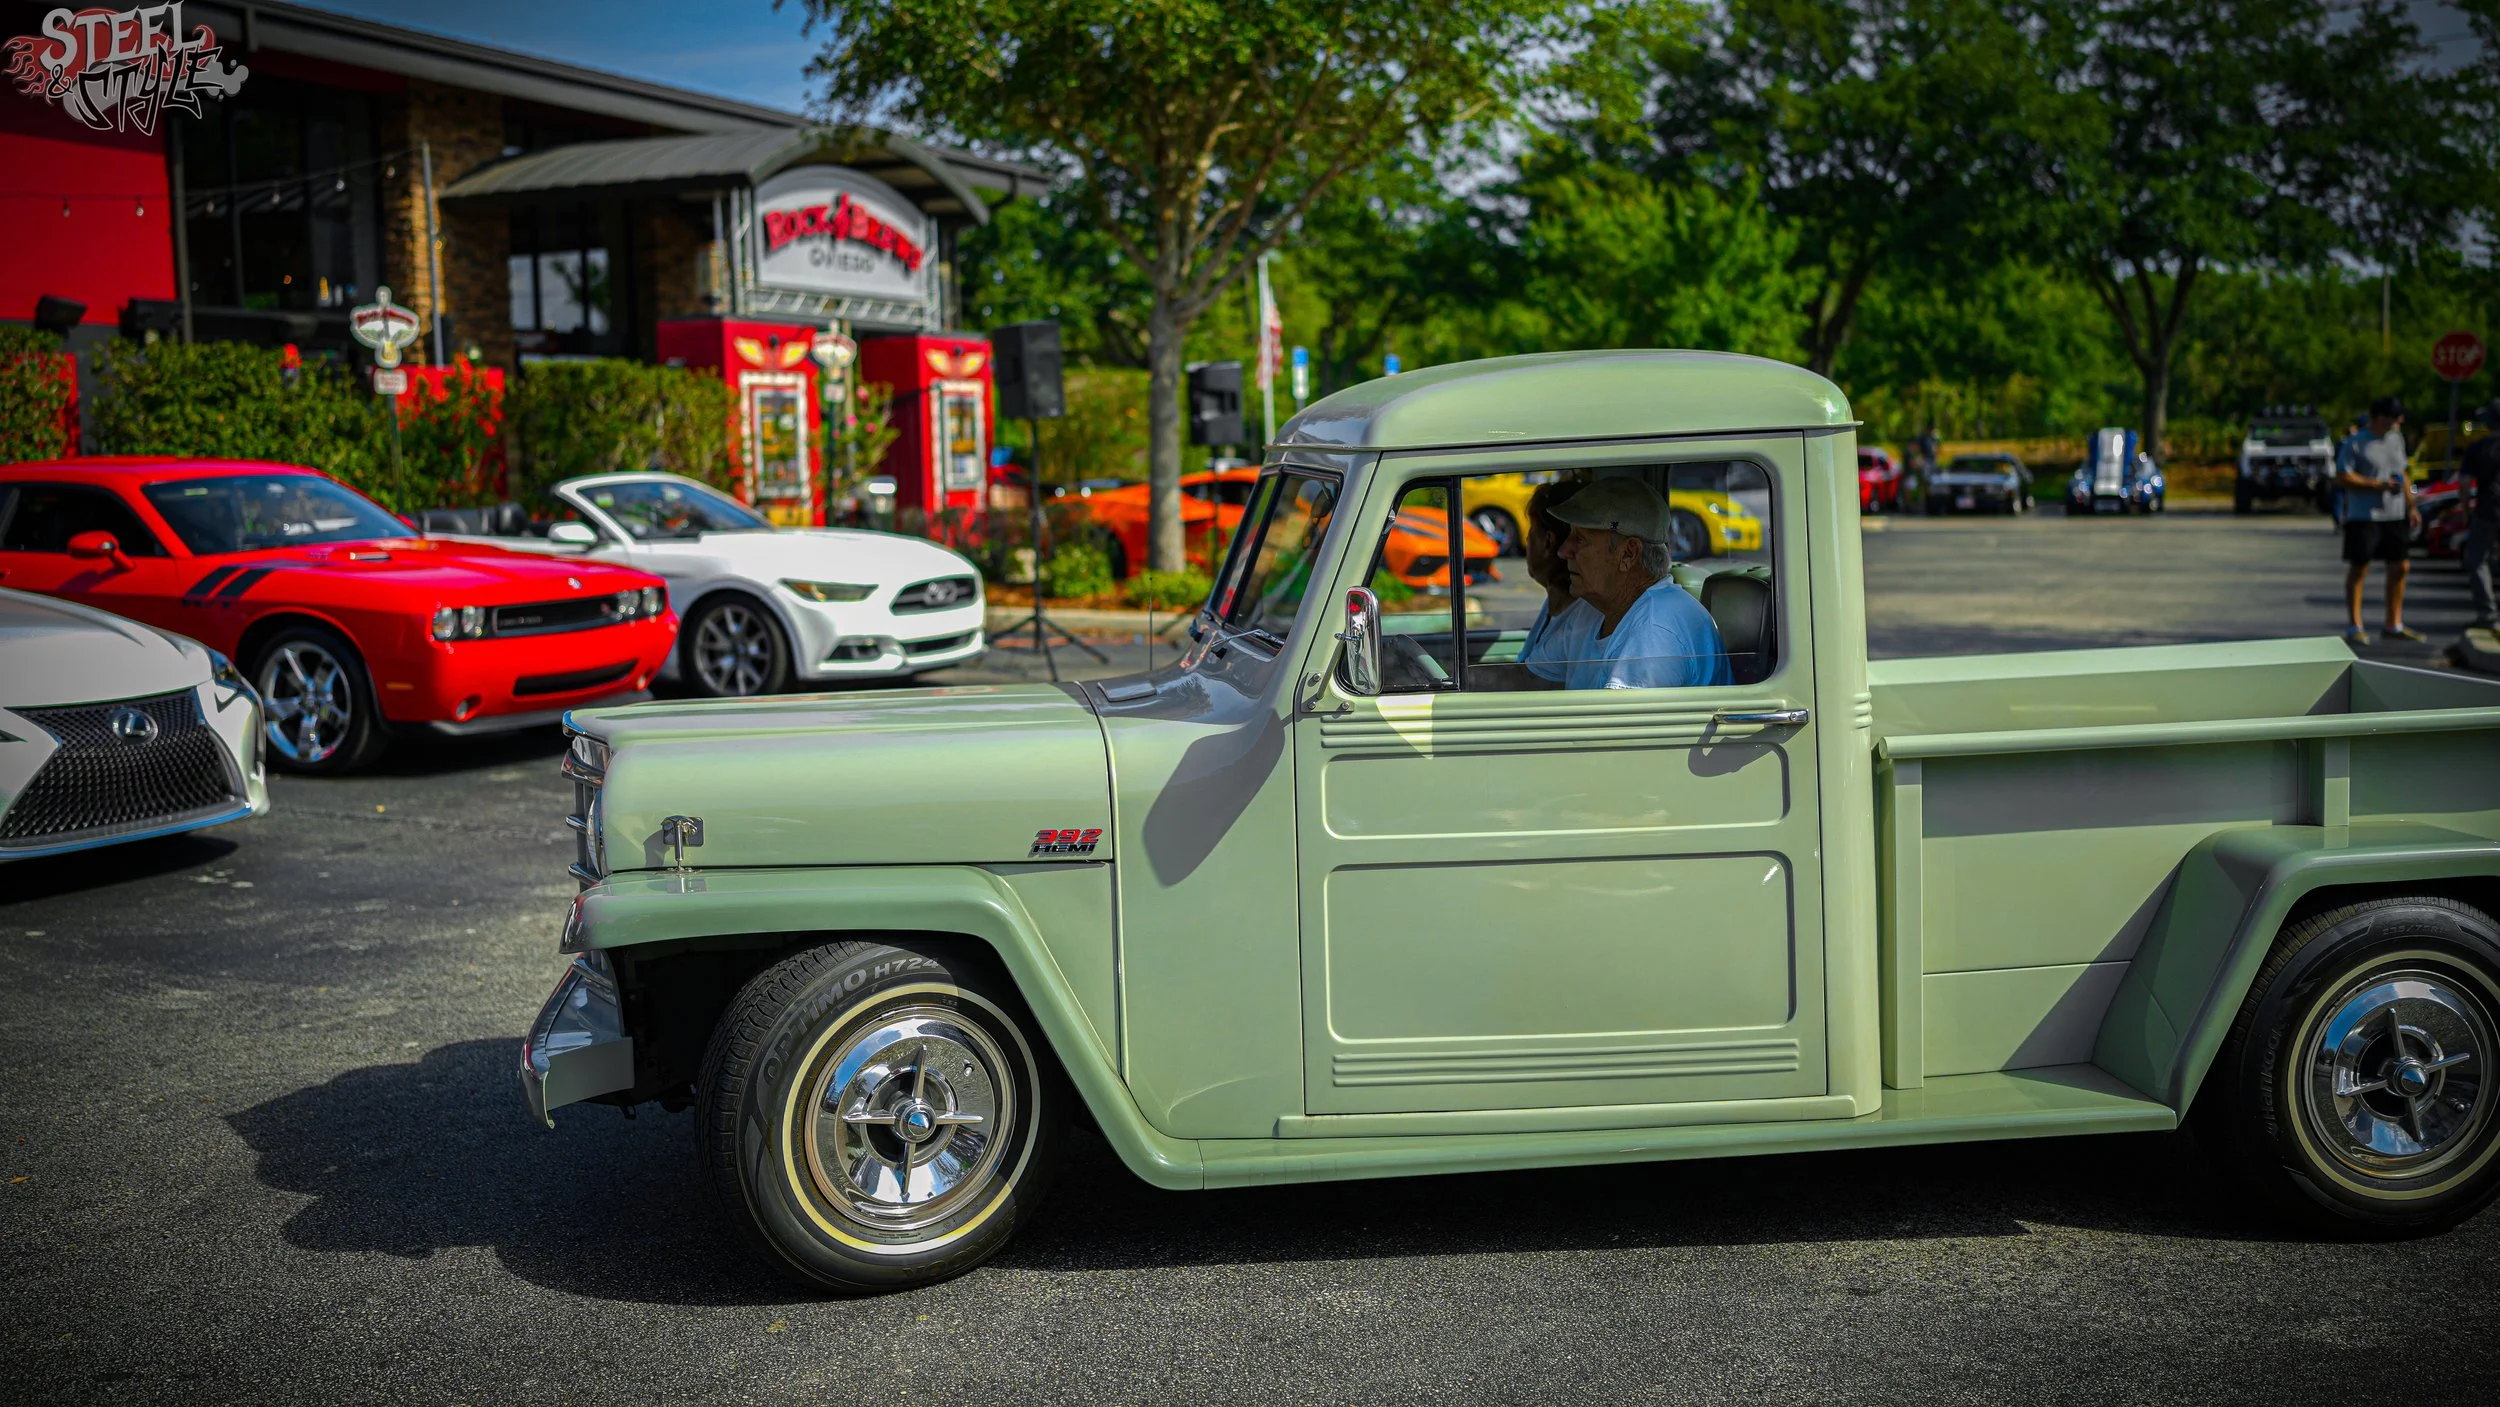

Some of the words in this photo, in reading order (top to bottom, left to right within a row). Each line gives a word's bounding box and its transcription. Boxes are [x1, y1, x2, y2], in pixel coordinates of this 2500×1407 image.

[1033, 828, 1103, 844] 392
[1030, 844, 1096, 853] HEMI
[763, 968, 867, 1086] OPTIMO
[874, 957, 940, 979] H724
